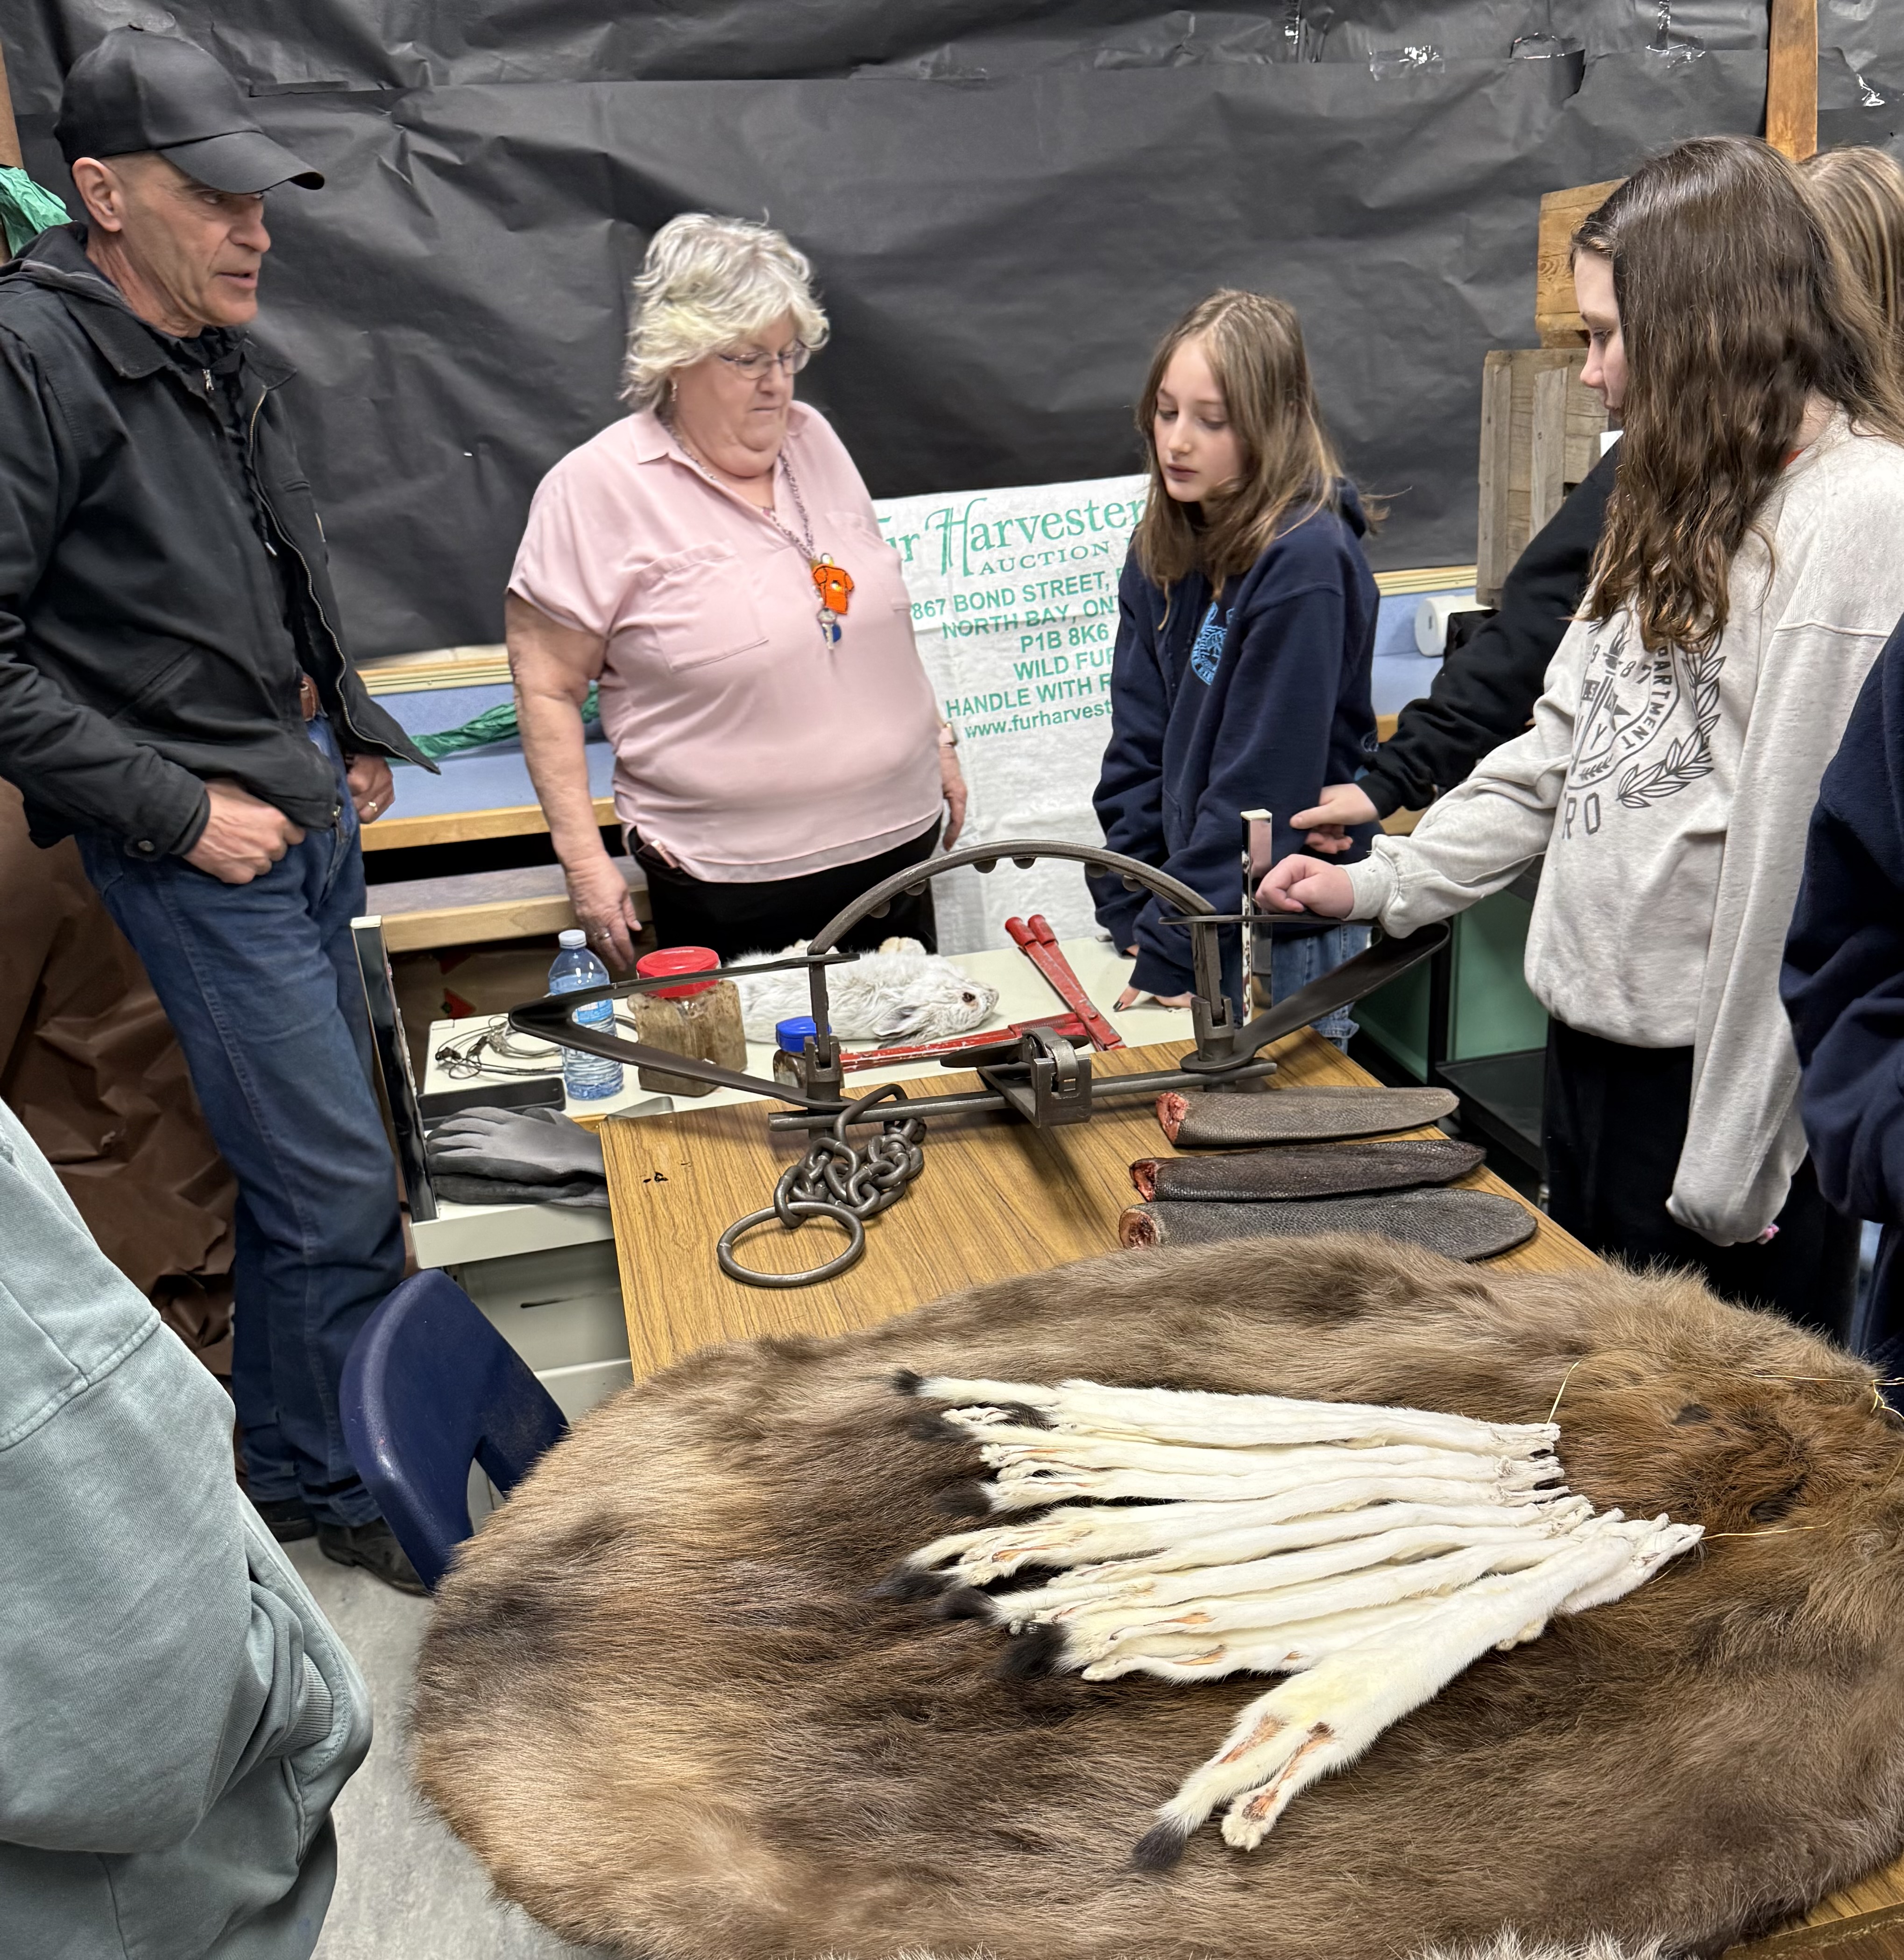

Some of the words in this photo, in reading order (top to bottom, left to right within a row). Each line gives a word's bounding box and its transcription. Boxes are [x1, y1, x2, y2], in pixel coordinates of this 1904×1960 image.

[980, 542, 1109, 576] AUCTION
[953, 588, 1015, 613] BOND
[1022, 571, 1109, 602] STREET,
[941, 613, 1018, 639] NORTH
[1025, 605, 1075, 628] BAY,
[1083, 595, 1118, 618] ON
[1019, 631, 1062, 654] P1B
[1068, 623, 1109, 647] 8K6
[1013, 656, 1069, 681] WILD
[946, 688, 1032, 719] HANDLE
[1035, 677, 1092, 704] WITH
